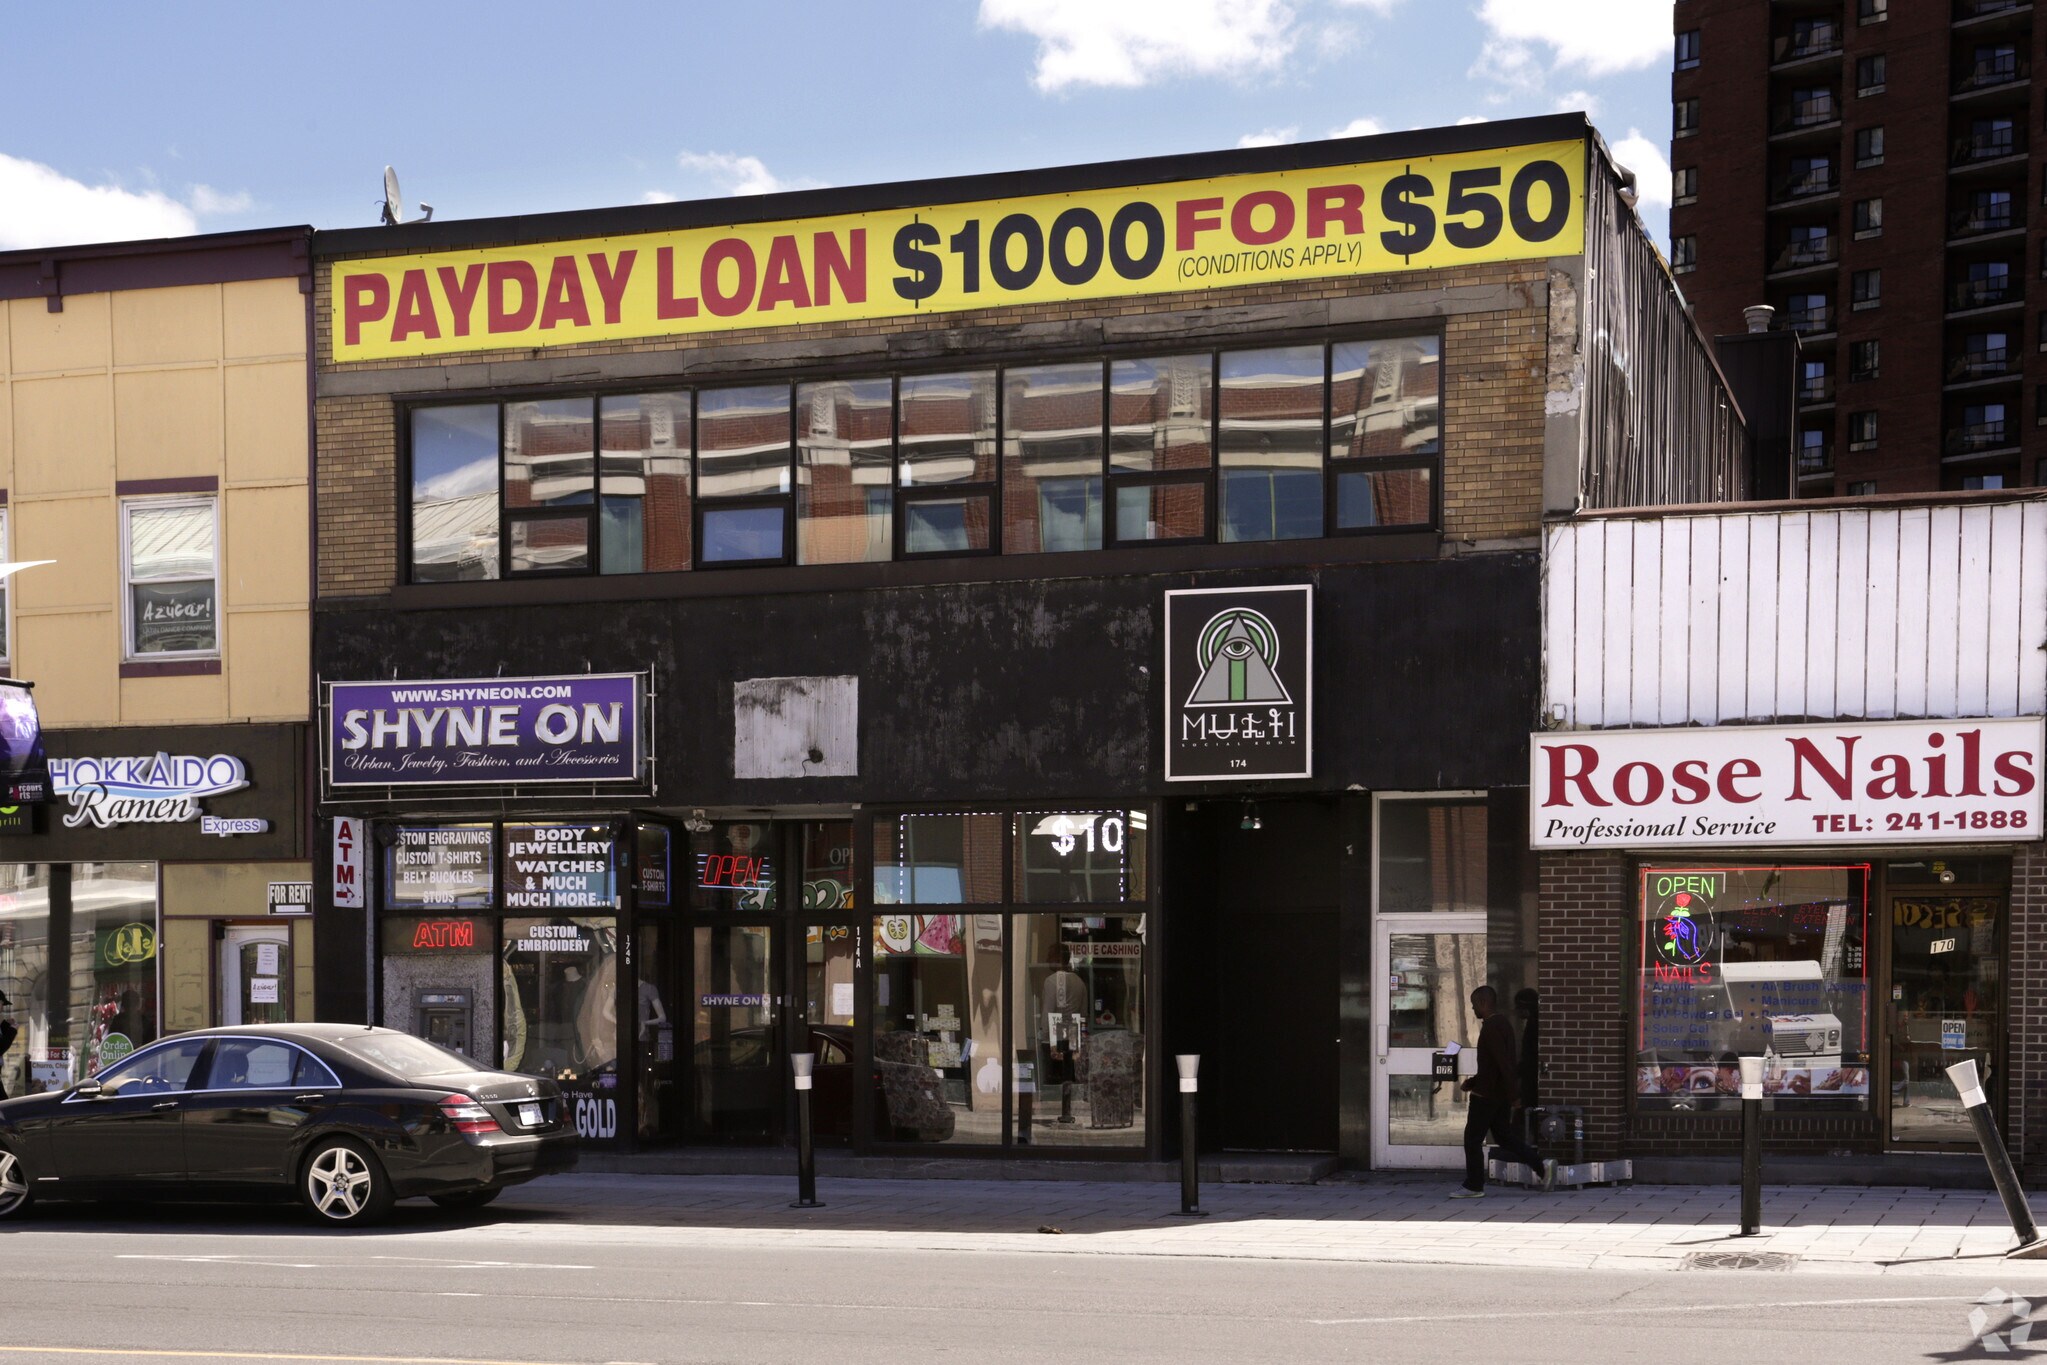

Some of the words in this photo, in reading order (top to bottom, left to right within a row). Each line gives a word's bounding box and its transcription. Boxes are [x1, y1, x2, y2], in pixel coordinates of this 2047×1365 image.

[344, 250, 637, 345] PAYDAY
[657, 228, 867, 319] LOAN
[892, 202, 1165, 308] $1000
[1176, 183, 1365, 250] FOR
[1381, 160, 1571, 265] $50
[1178, 248, 1294, 282] (CONDITIONS
[1300, 241, 1362, 266] APPLY)
[391, 686, 571, 703] WWW.SHYNEON.COM
[342, 704, 521, 750] SHYNE
[535, 702, 623, 745] ON
[344, 753, 392, 771] Urban
[515, 752, 540, 767] and
[545, 748, 620, 767] Accessories
[1229, 759, 1248, 769] 174
[50, 757, 235, 787] HOKKAIDO
[1540, 743, 1763, 808] Rose
[1785, 729, 2036, 802] Nails
[66, 782, 191, 825] Ramen
[203, 817, 259, 834] Express
[1545, 817, 1688, 845] Professional
[1692, 815, 1777, 837] Service
[1812, 813, 1874, 832] TEL:
[1885, 809, 2028, 832] 241-1888
[428, 831, 491, 846] ENGRAVINGS
[534, 829, 586, 842] BODY
[337, 820, 354, 885] ATM
[508, 842, 612, 858] JEWELLERY
[396, 852, 436, 865] CUSTOM
[438, 851, 482, 865] T-SHIRTS
[515, 860, 605, 873] WATCHES
[702, 854, 762, 888] OPEN
[403, 871, 428, 885] BELT
[429, 870, 474, 884] BUCKLES
[642, 868, 665, 881] CUSTOM
[524, 876, 536, 890] &
[541, 876, 587, 890] MUCH
[642, 880, 666, 893] T-SHIRTS
[1656, 876, 1715, 898] OPEN
[269, 884, 287, 904] FOR
[288, 884, 312, 904] RENT
[422, 890, 455, 904] STUDS
[506, 893, 551, 907] MUCH
[552, 892, 611, 907] MORE...
[413, 921, 474, 948] ATM
[529, 925, 577, 939] CUSTOM
[517, 938, 590, 952] EMBROIDERY
[1069, 943, 1099, 956] HEQUE
[1101, 943, 1140, 956] CASHING
[1932, 939, 1955, 953] 170
[1654, 960, 1713, 984] NAILS
[1783, 982, 1820, 992] Brush
[702, 996, 739, 1006] SHYNE
[741, 996, 760, 1005] ON
[1762, 996, 1819, 1006] Manicure
[1689, 1024, 1709, 1033] Gel
[1942, 1022, 1965, 1034] OPEN
[103, 1041, 129, 1050] Order
[101, 1050, 128, 1060] Onlin
[1436, 1065, 1454, 1075] 172
[571, 1091, 593, 1099] Have
[575, 1098, 617, 1139] GOLD
